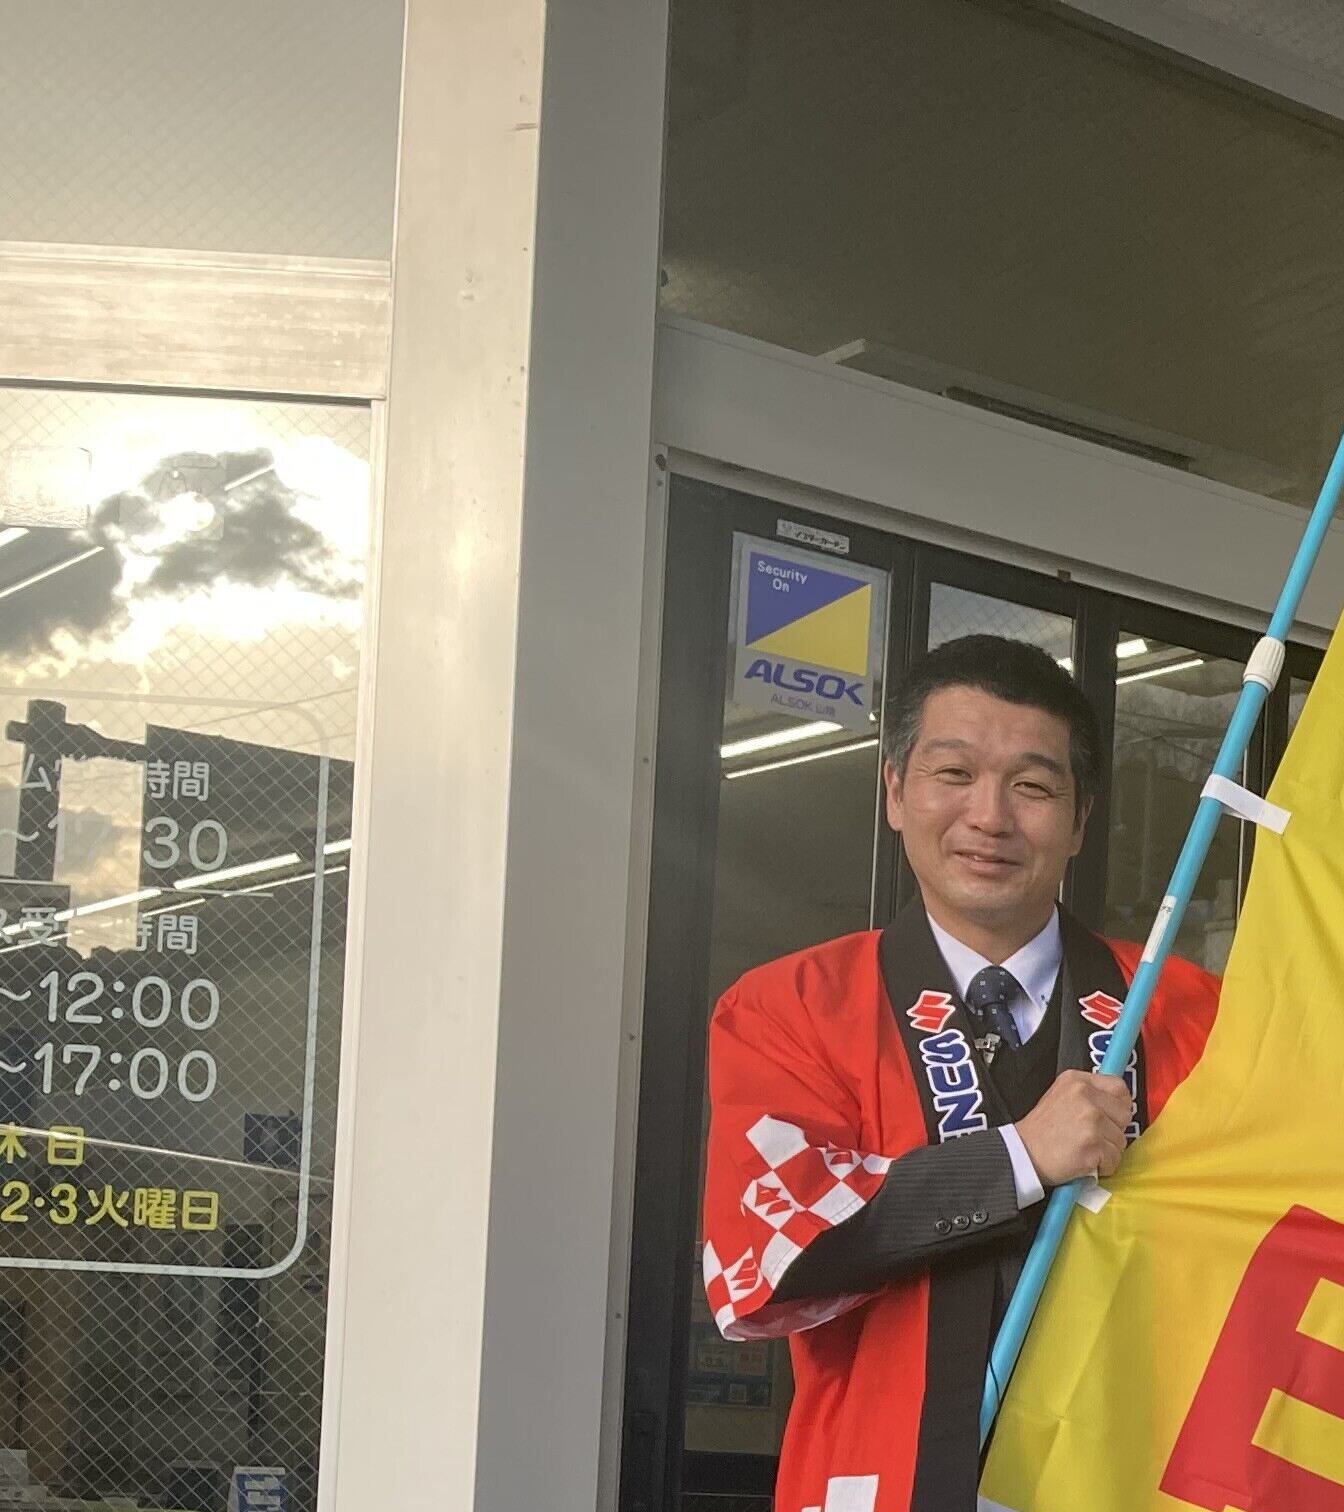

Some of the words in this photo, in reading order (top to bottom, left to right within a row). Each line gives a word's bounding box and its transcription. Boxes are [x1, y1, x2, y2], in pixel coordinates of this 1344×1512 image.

[757, 560, 808, 584] Security
[772, 578, 790, 593] On
[744, 659, 864, 706] ALSOK
[919, 1028, 988, 1144] SUZ
